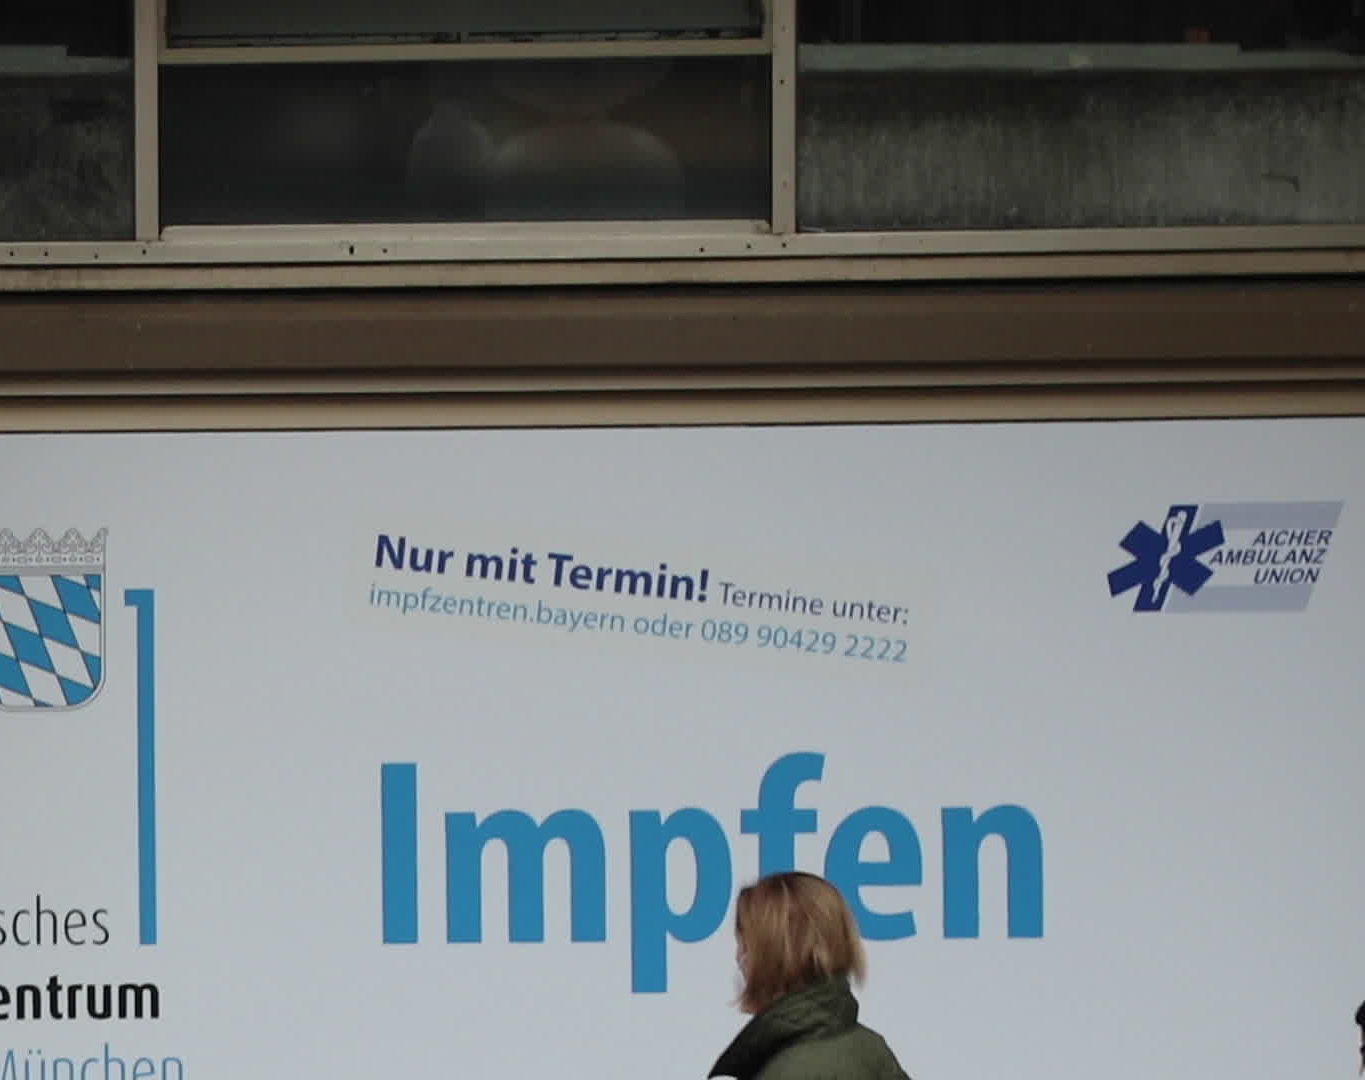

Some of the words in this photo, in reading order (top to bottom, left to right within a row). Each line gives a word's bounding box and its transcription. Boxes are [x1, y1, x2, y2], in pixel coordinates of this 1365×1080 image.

[1209, 549, 1326, 566] AMBULANZ
[1253, 530, 1332, 547] AICHER
[374, 534, 455, 575] Nur
[465, 546, 538, 585] mit
[547, 552, 709, 603] Termin!
[719, 582, 824, 617] Termine
[832, 599, 909, 626] unter:
[1254, 568, 1320, 584] UNION
[369, 583, 625, 633] impfzentren.bayern
[633, 613, 695, 641] oder
[700, 619, 750, 646] 089
[757, 625, 837, 656] 90429
[843, 633, 908, 664] 2222
[381, 751, 1044, 994] Impfen
